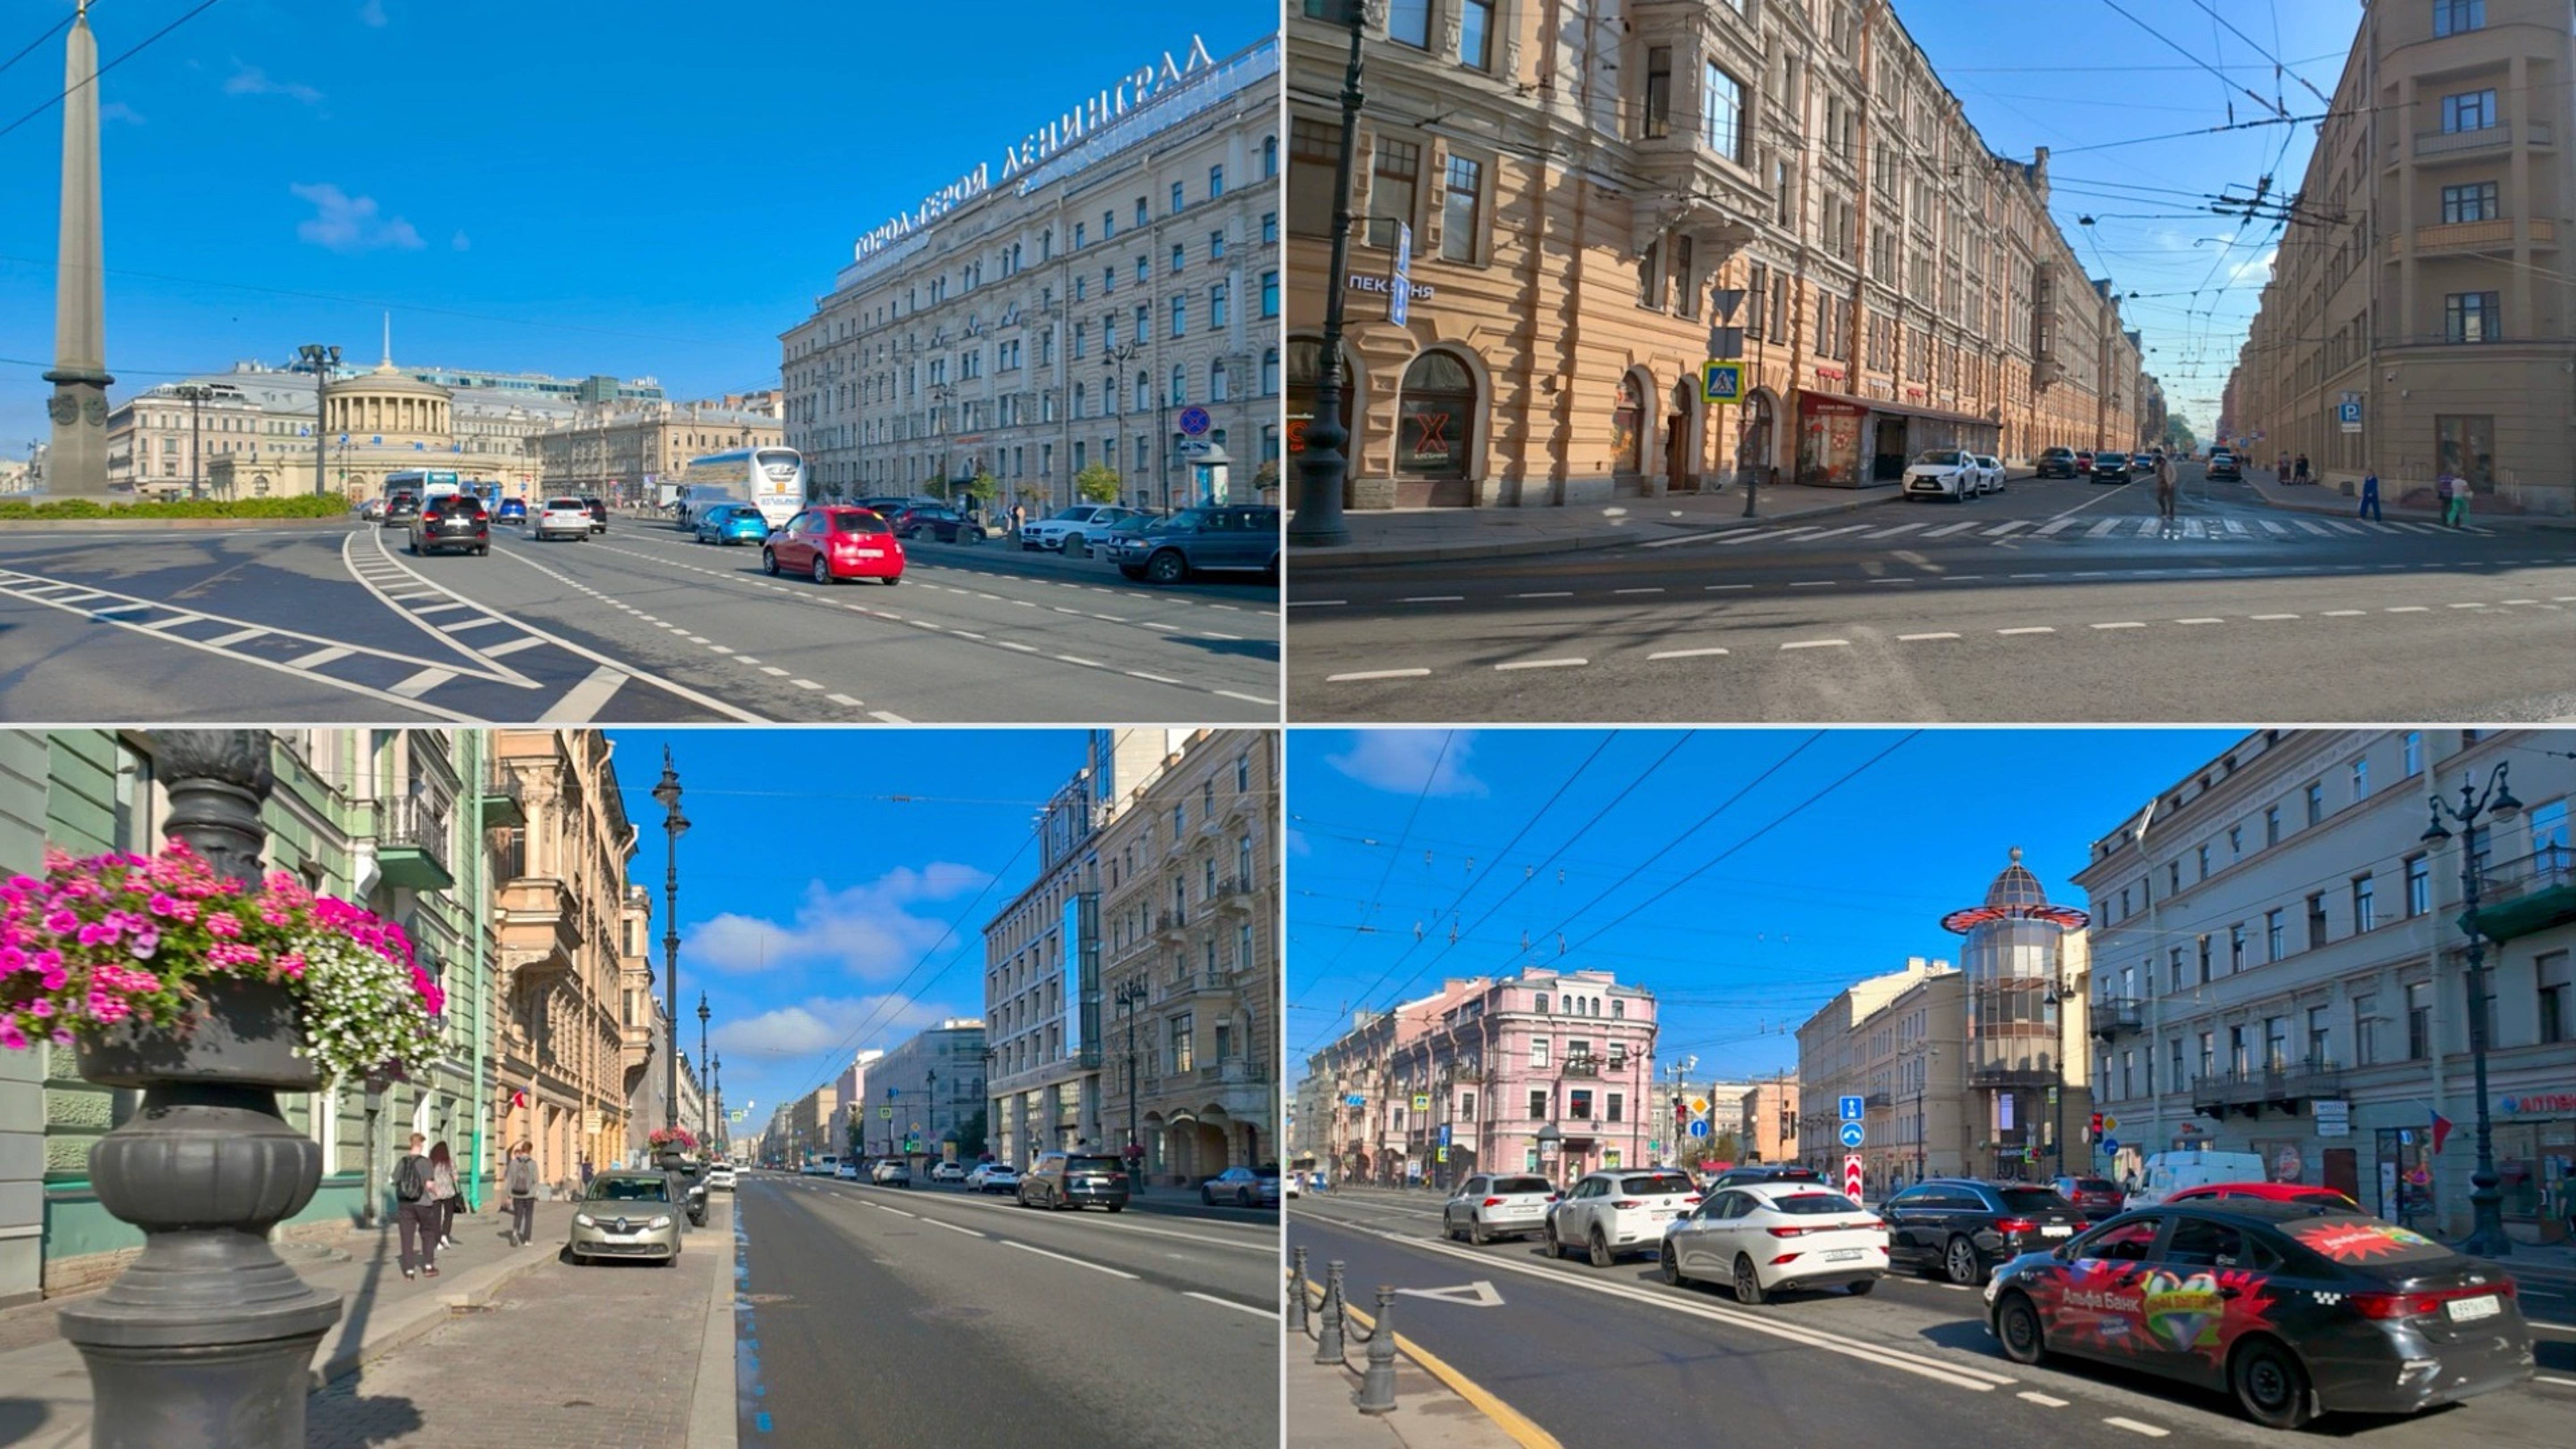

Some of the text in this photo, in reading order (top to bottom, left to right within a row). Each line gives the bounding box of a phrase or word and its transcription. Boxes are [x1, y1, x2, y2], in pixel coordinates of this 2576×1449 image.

[1003, 33, 1215, 178] ЛЕНИНГРАД
[1349, 275, 1435, 299] ПЕКНЯ
[2063, 1287, 2103, 1312] Альфа
[2104, 1291, 2142, 1313] Банк
